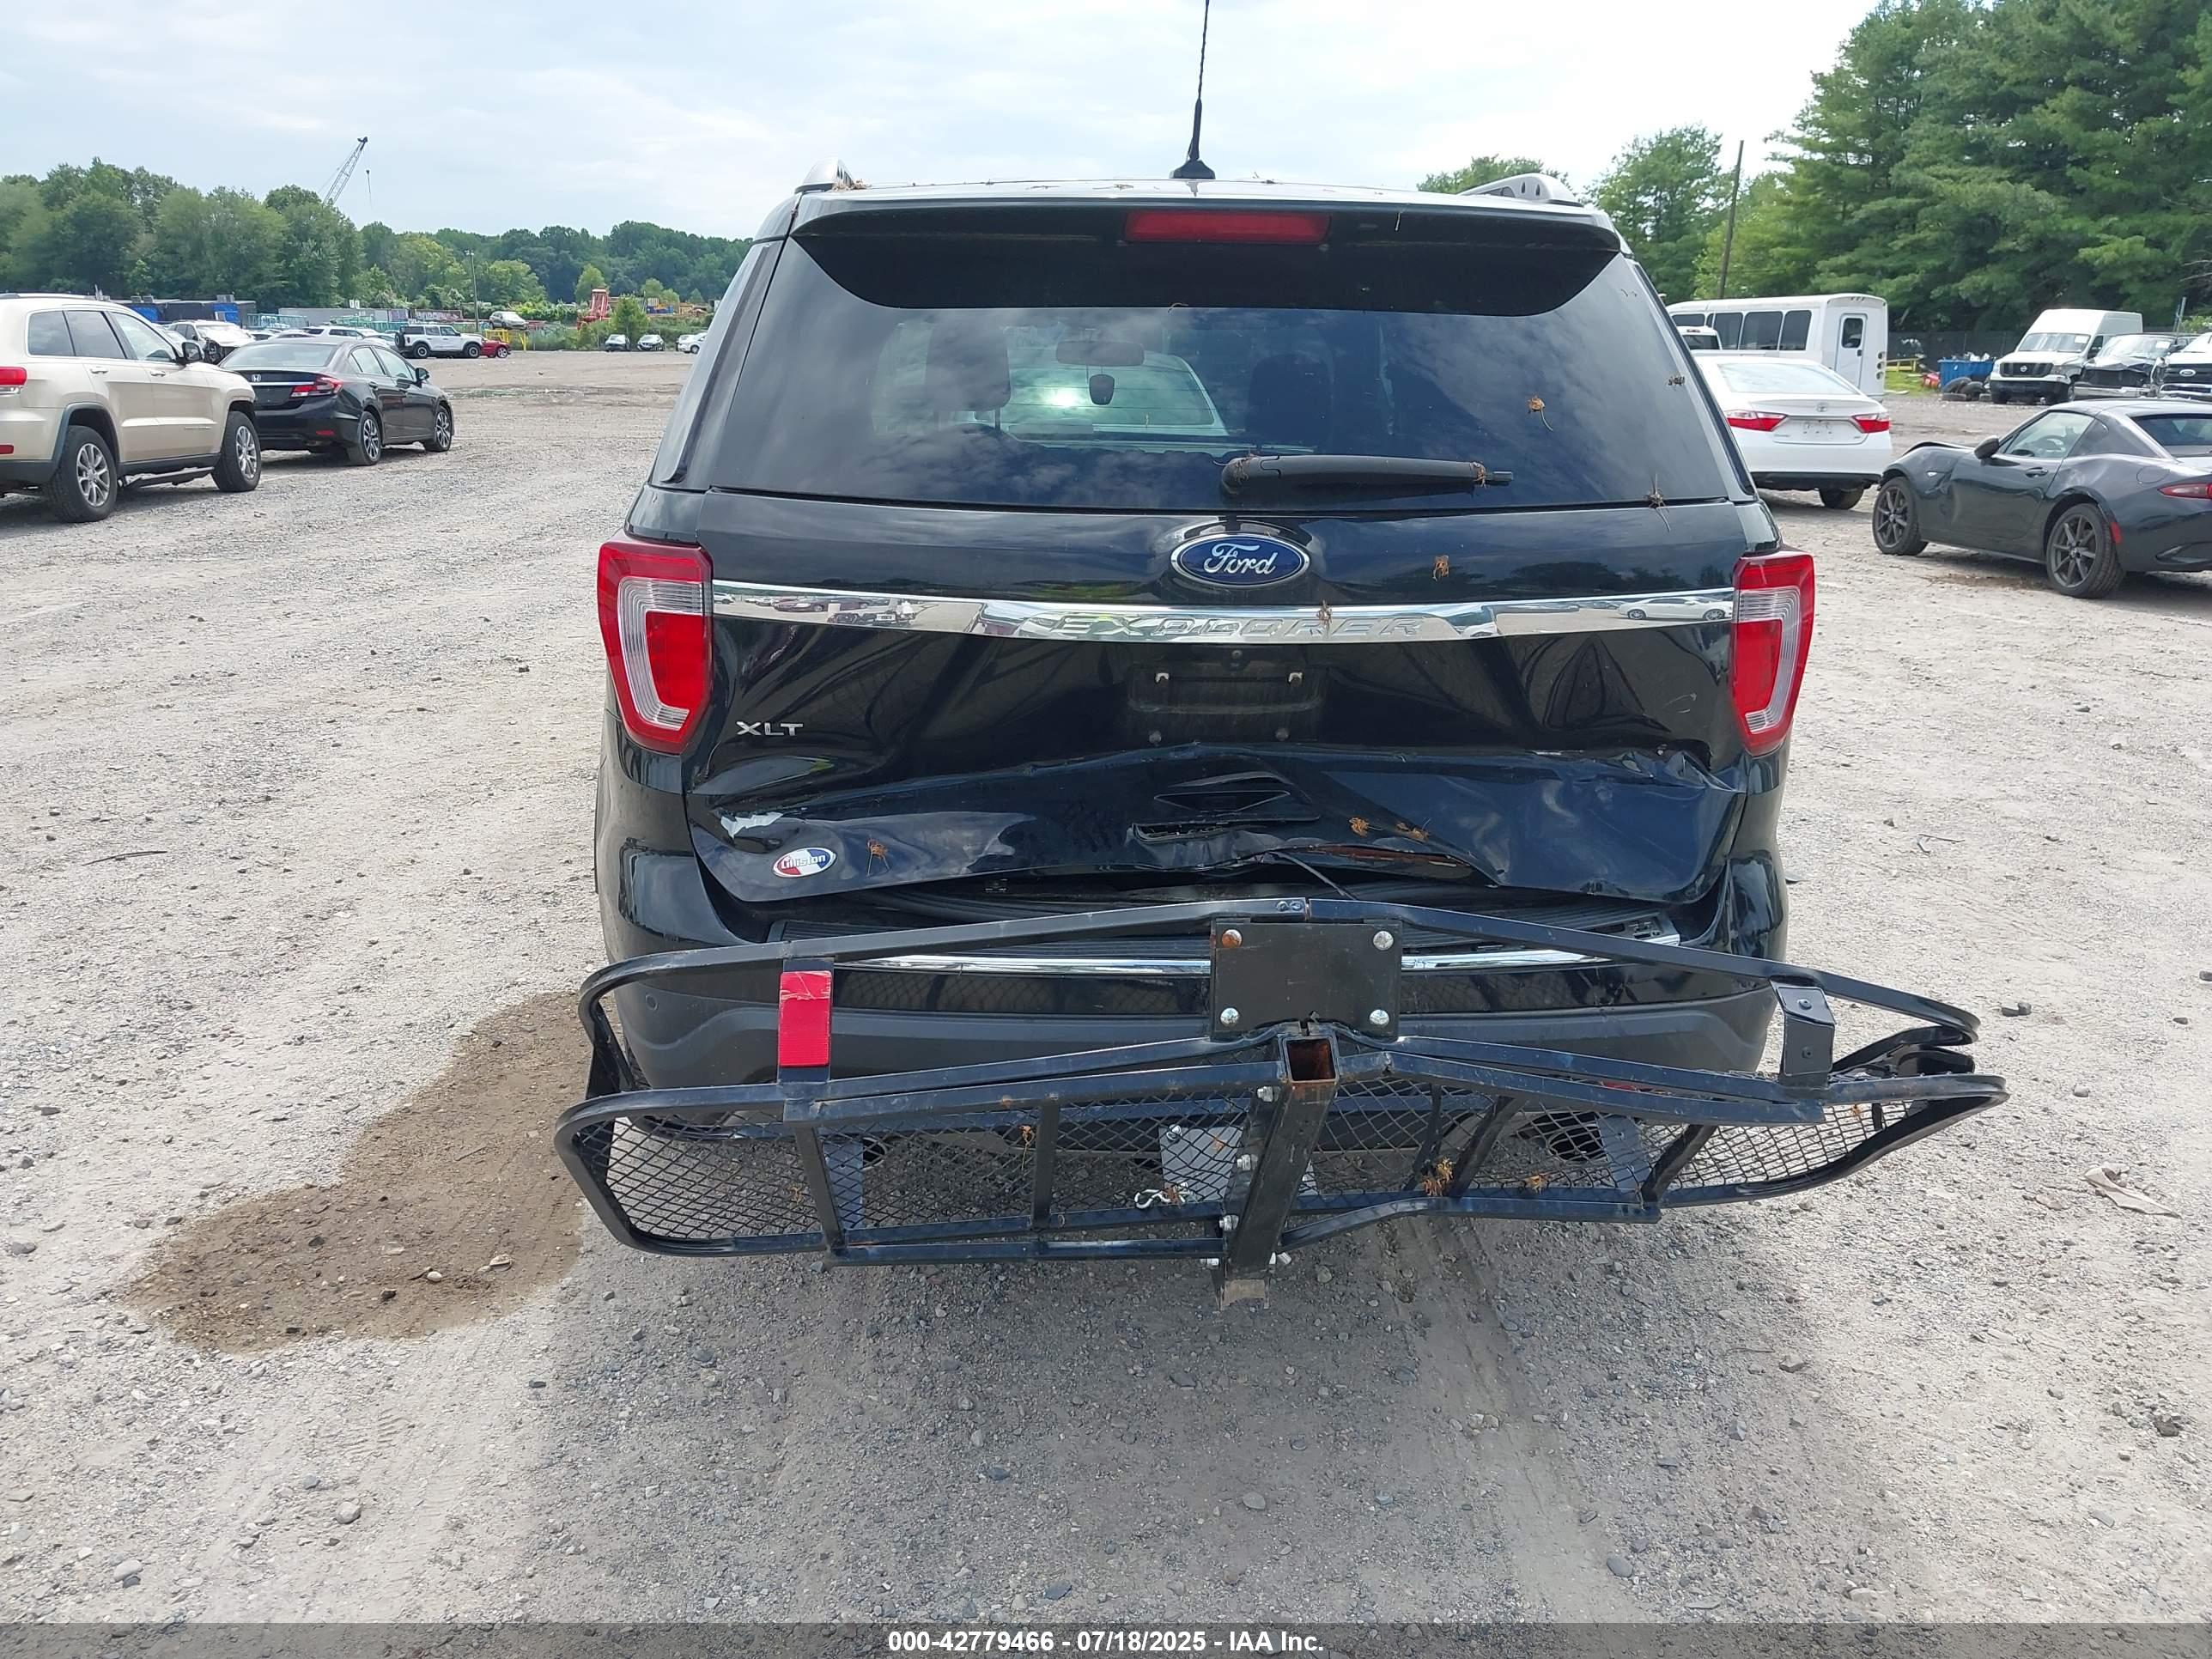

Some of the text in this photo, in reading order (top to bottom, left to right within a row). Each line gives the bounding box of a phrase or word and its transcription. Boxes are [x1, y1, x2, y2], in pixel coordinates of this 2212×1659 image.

[1204, 543, 1279, 574] Ford
[1050, 614, 1426, 637] EXPLORER
[736, 720, 804, 736] XLT
